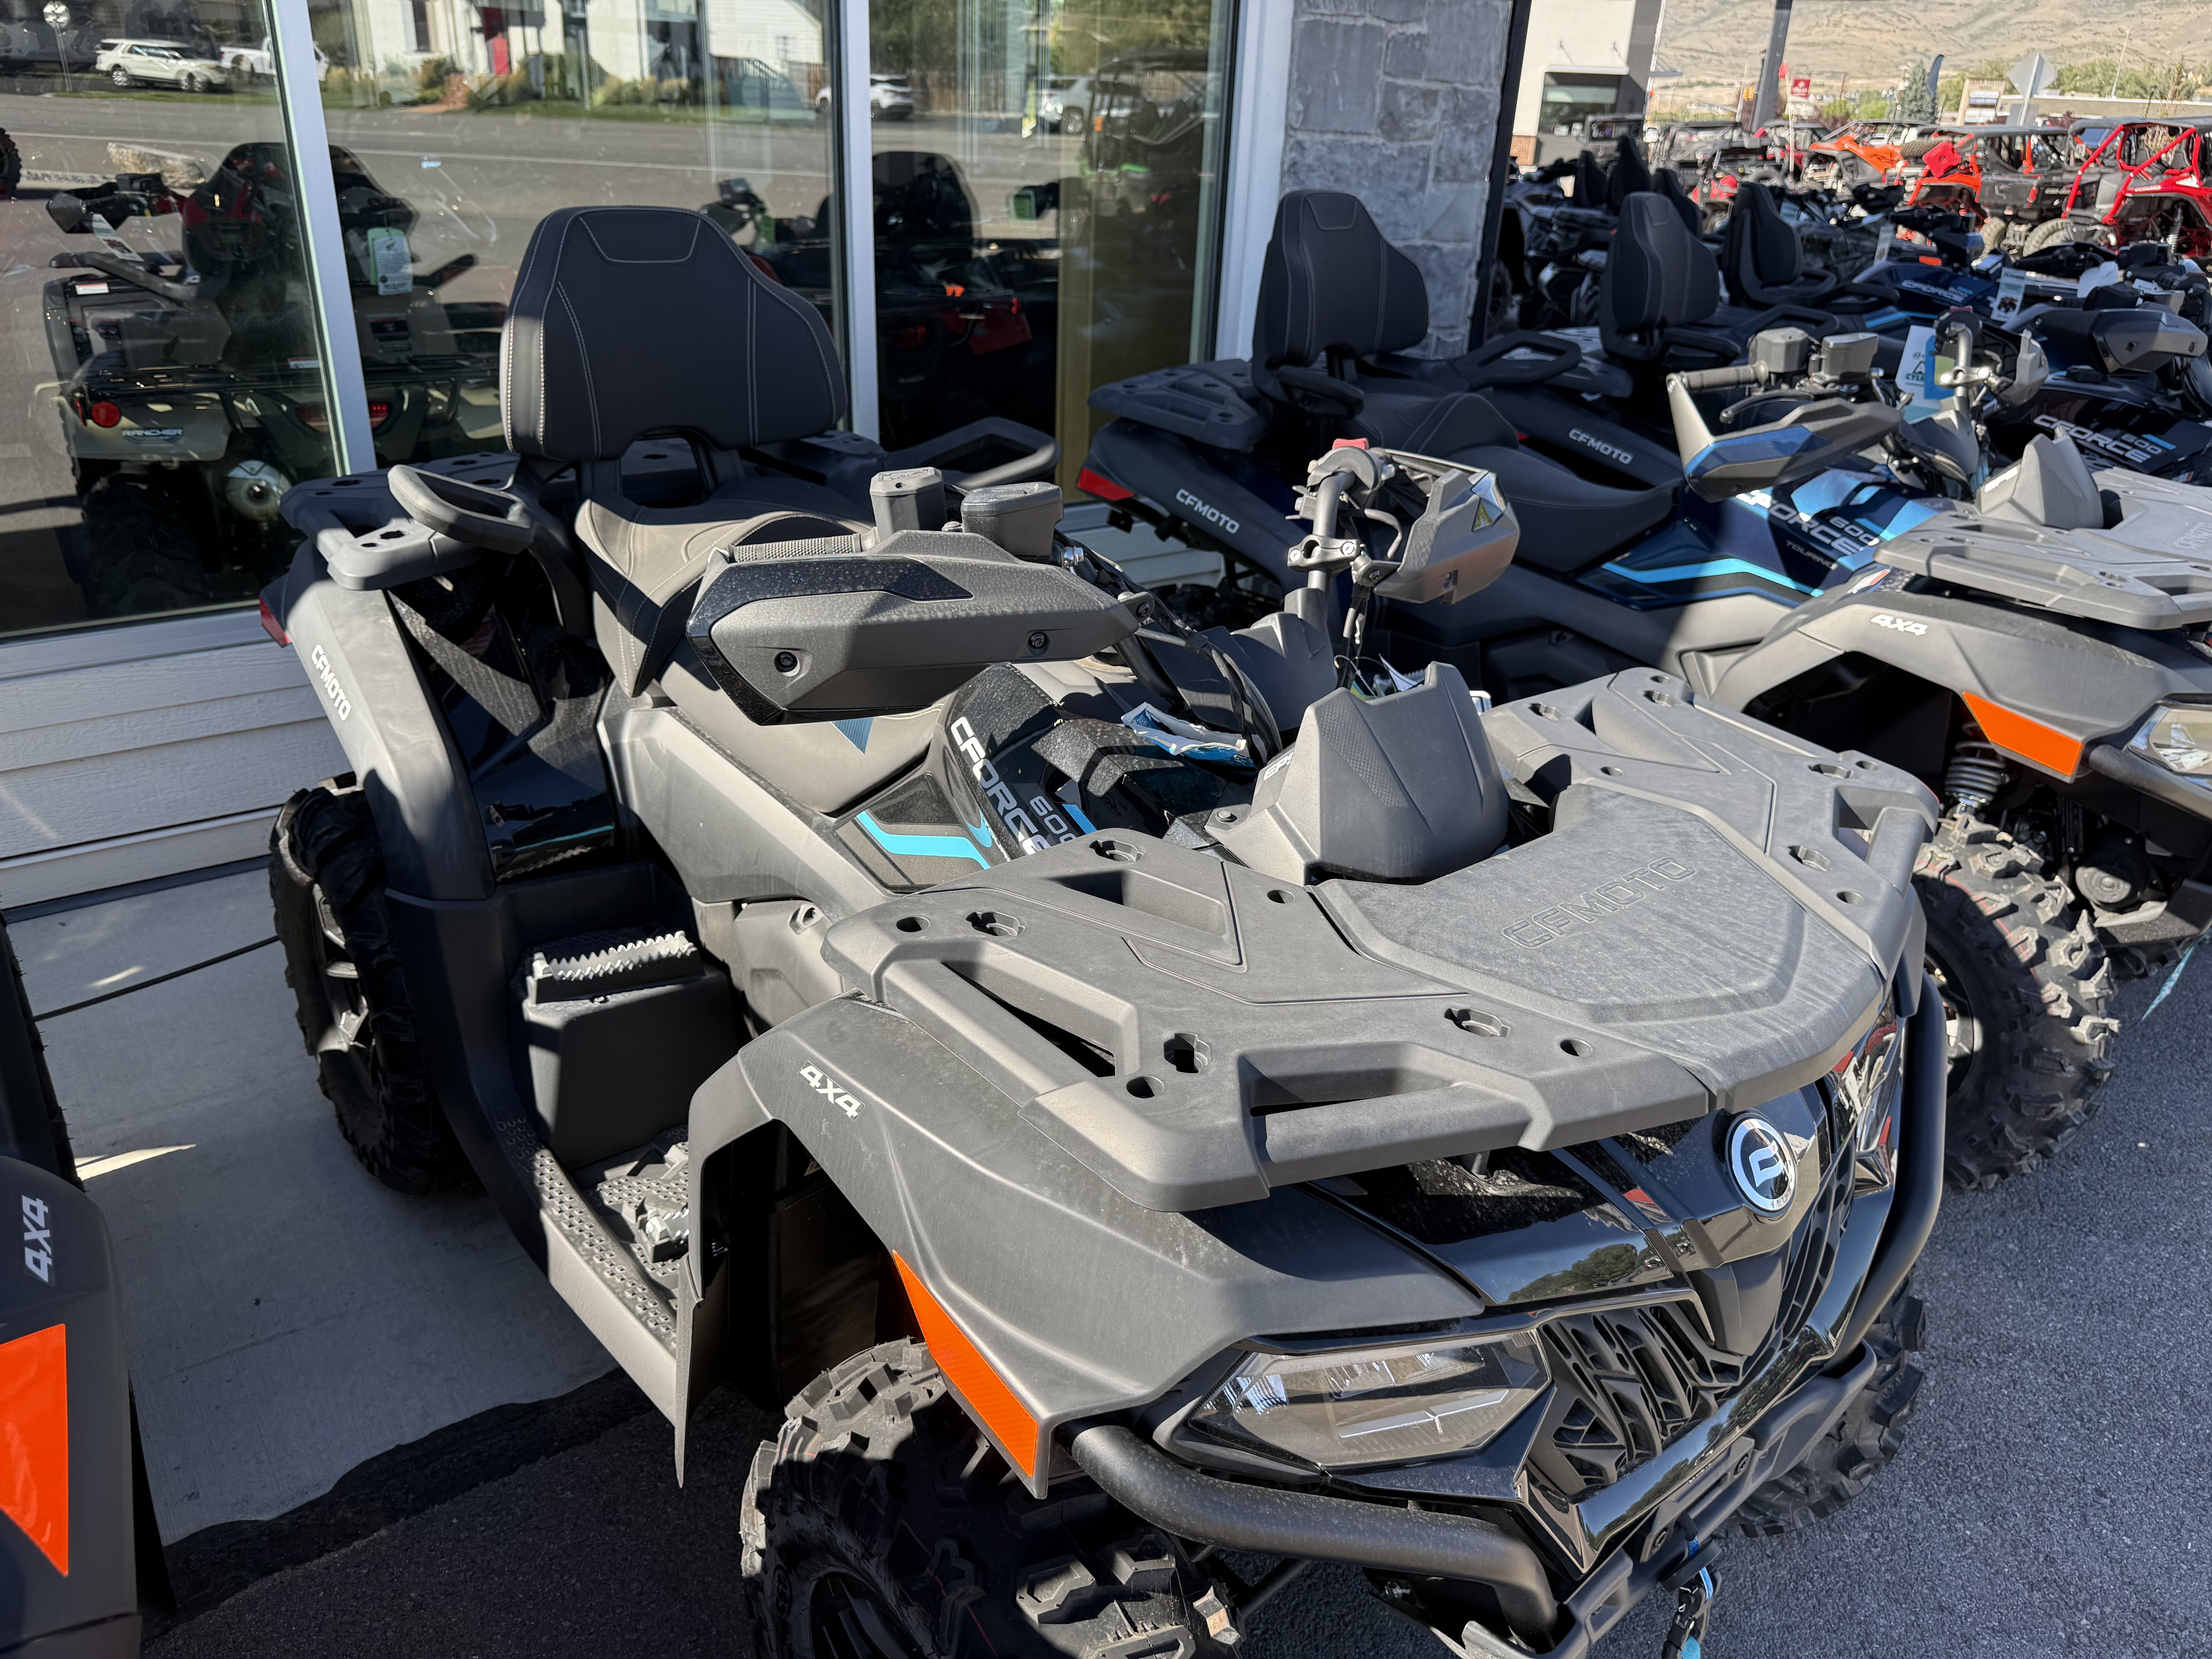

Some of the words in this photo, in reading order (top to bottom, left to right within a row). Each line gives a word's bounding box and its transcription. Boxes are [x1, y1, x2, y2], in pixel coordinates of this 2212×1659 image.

[1569, 428, 1633, 465] CFMOTO
[2033, 414, 2152, 464] CFORCE
[1176, 488, 1240, 534] CFMOTO
[1829, 515, 1880, 546] 600
[1786, 541, 1839, 570] TOURING
[1870, 614, 1928, 636] 4X4
[311, 644, 351, 721] CFMOTO
[1501, 857, 1696, 948] CFMOTO
[800, 1065, 861, 1118] 4X4
[22, 1195, 52, 1283] 4X4
